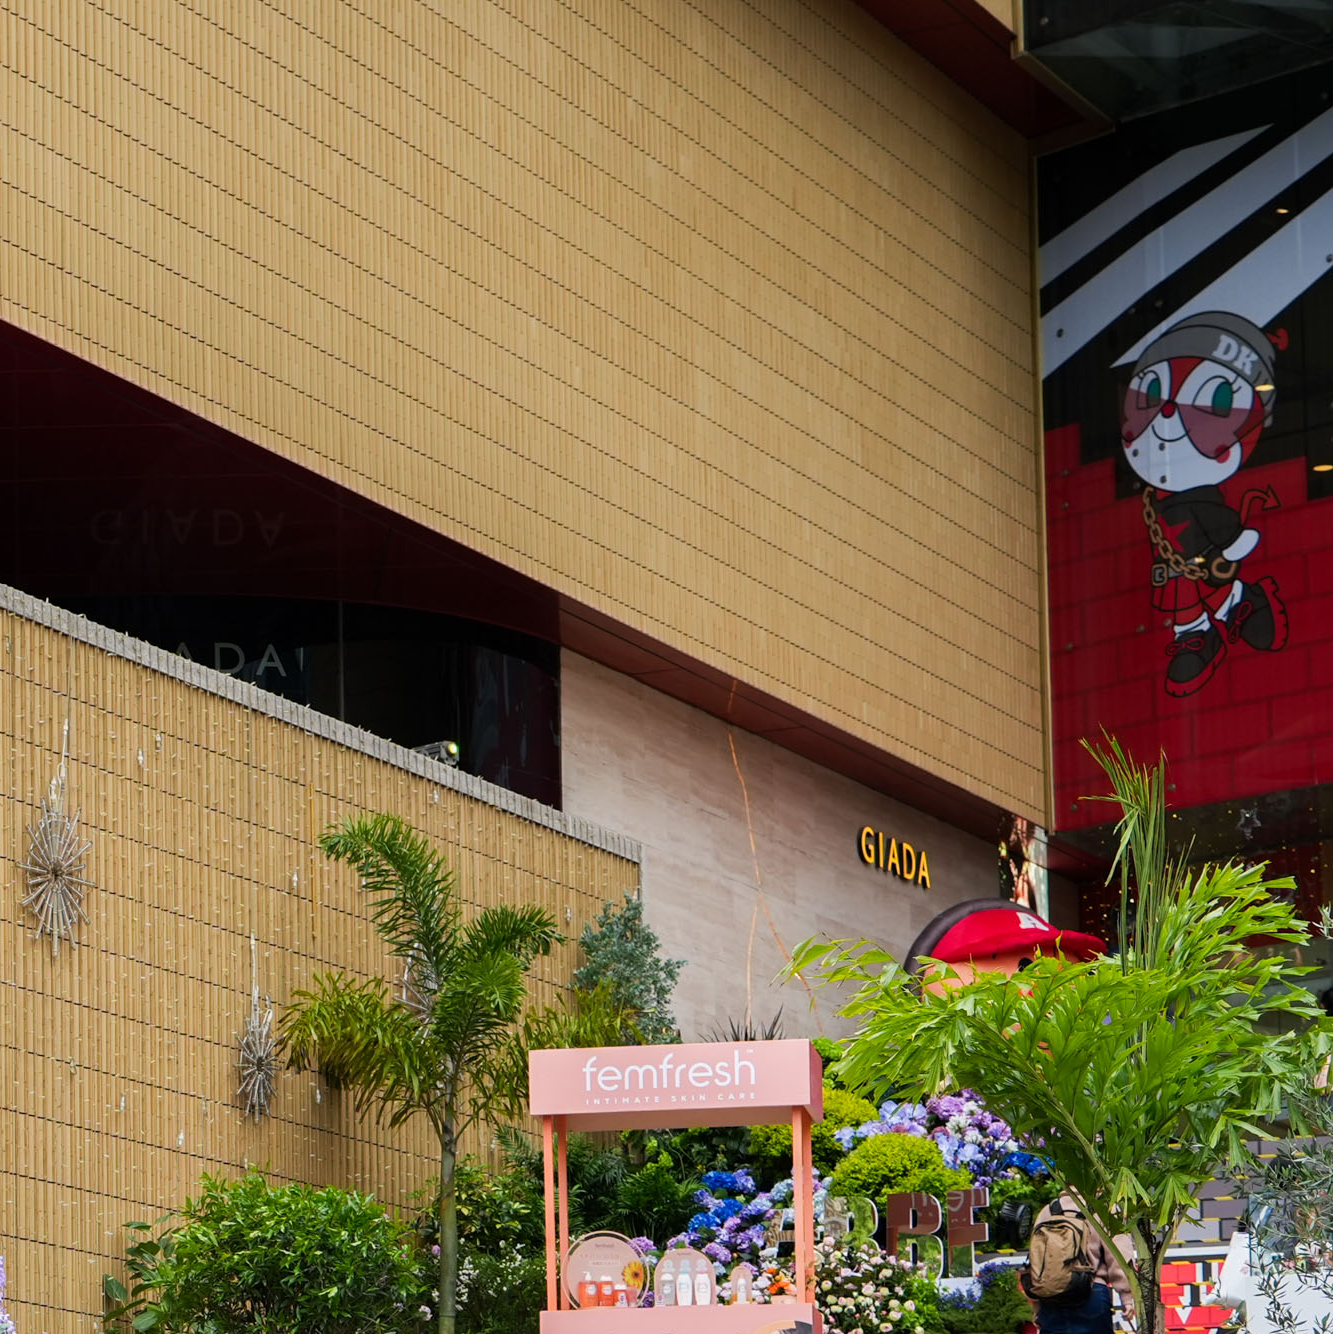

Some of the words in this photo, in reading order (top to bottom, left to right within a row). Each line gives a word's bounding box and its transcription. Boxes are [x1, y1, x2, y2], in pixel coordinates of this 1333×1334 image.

[1212, 334, 1259, 375] DK
[860, 826, 931, 889] GIADA
[582, 1050, 756, 1092] femfresh
[585, 1095, 661, 1105] INTIMATE
[671, 1094, 707, 1102] SKIN
[717, 1091, 756, 1101] CARE
